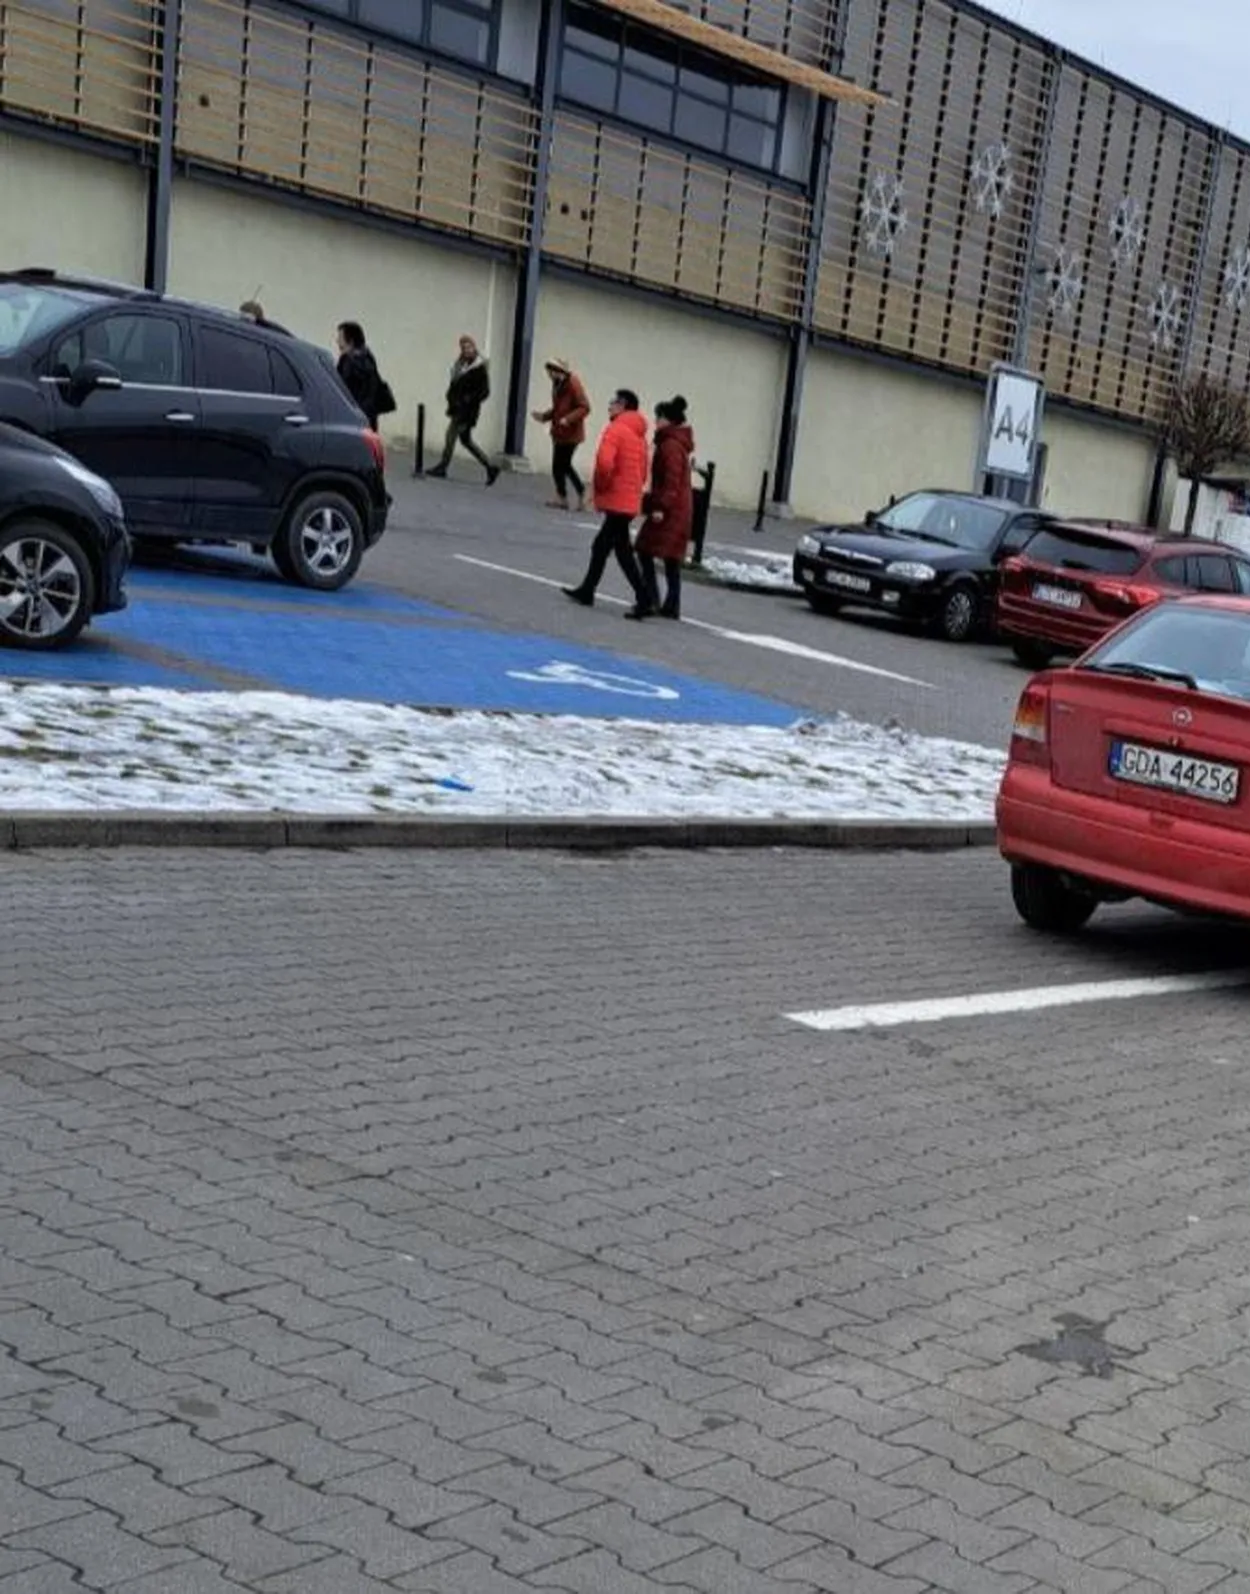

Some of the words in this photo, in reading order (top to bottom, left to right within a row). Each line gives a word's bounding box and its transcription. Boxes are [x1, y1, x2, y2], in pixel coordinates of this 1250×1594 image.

[995, 404, 1031, 446] A4
[1124, 747, 1160, 778] GDA
[1170, 759, 1234, 795] 44256
